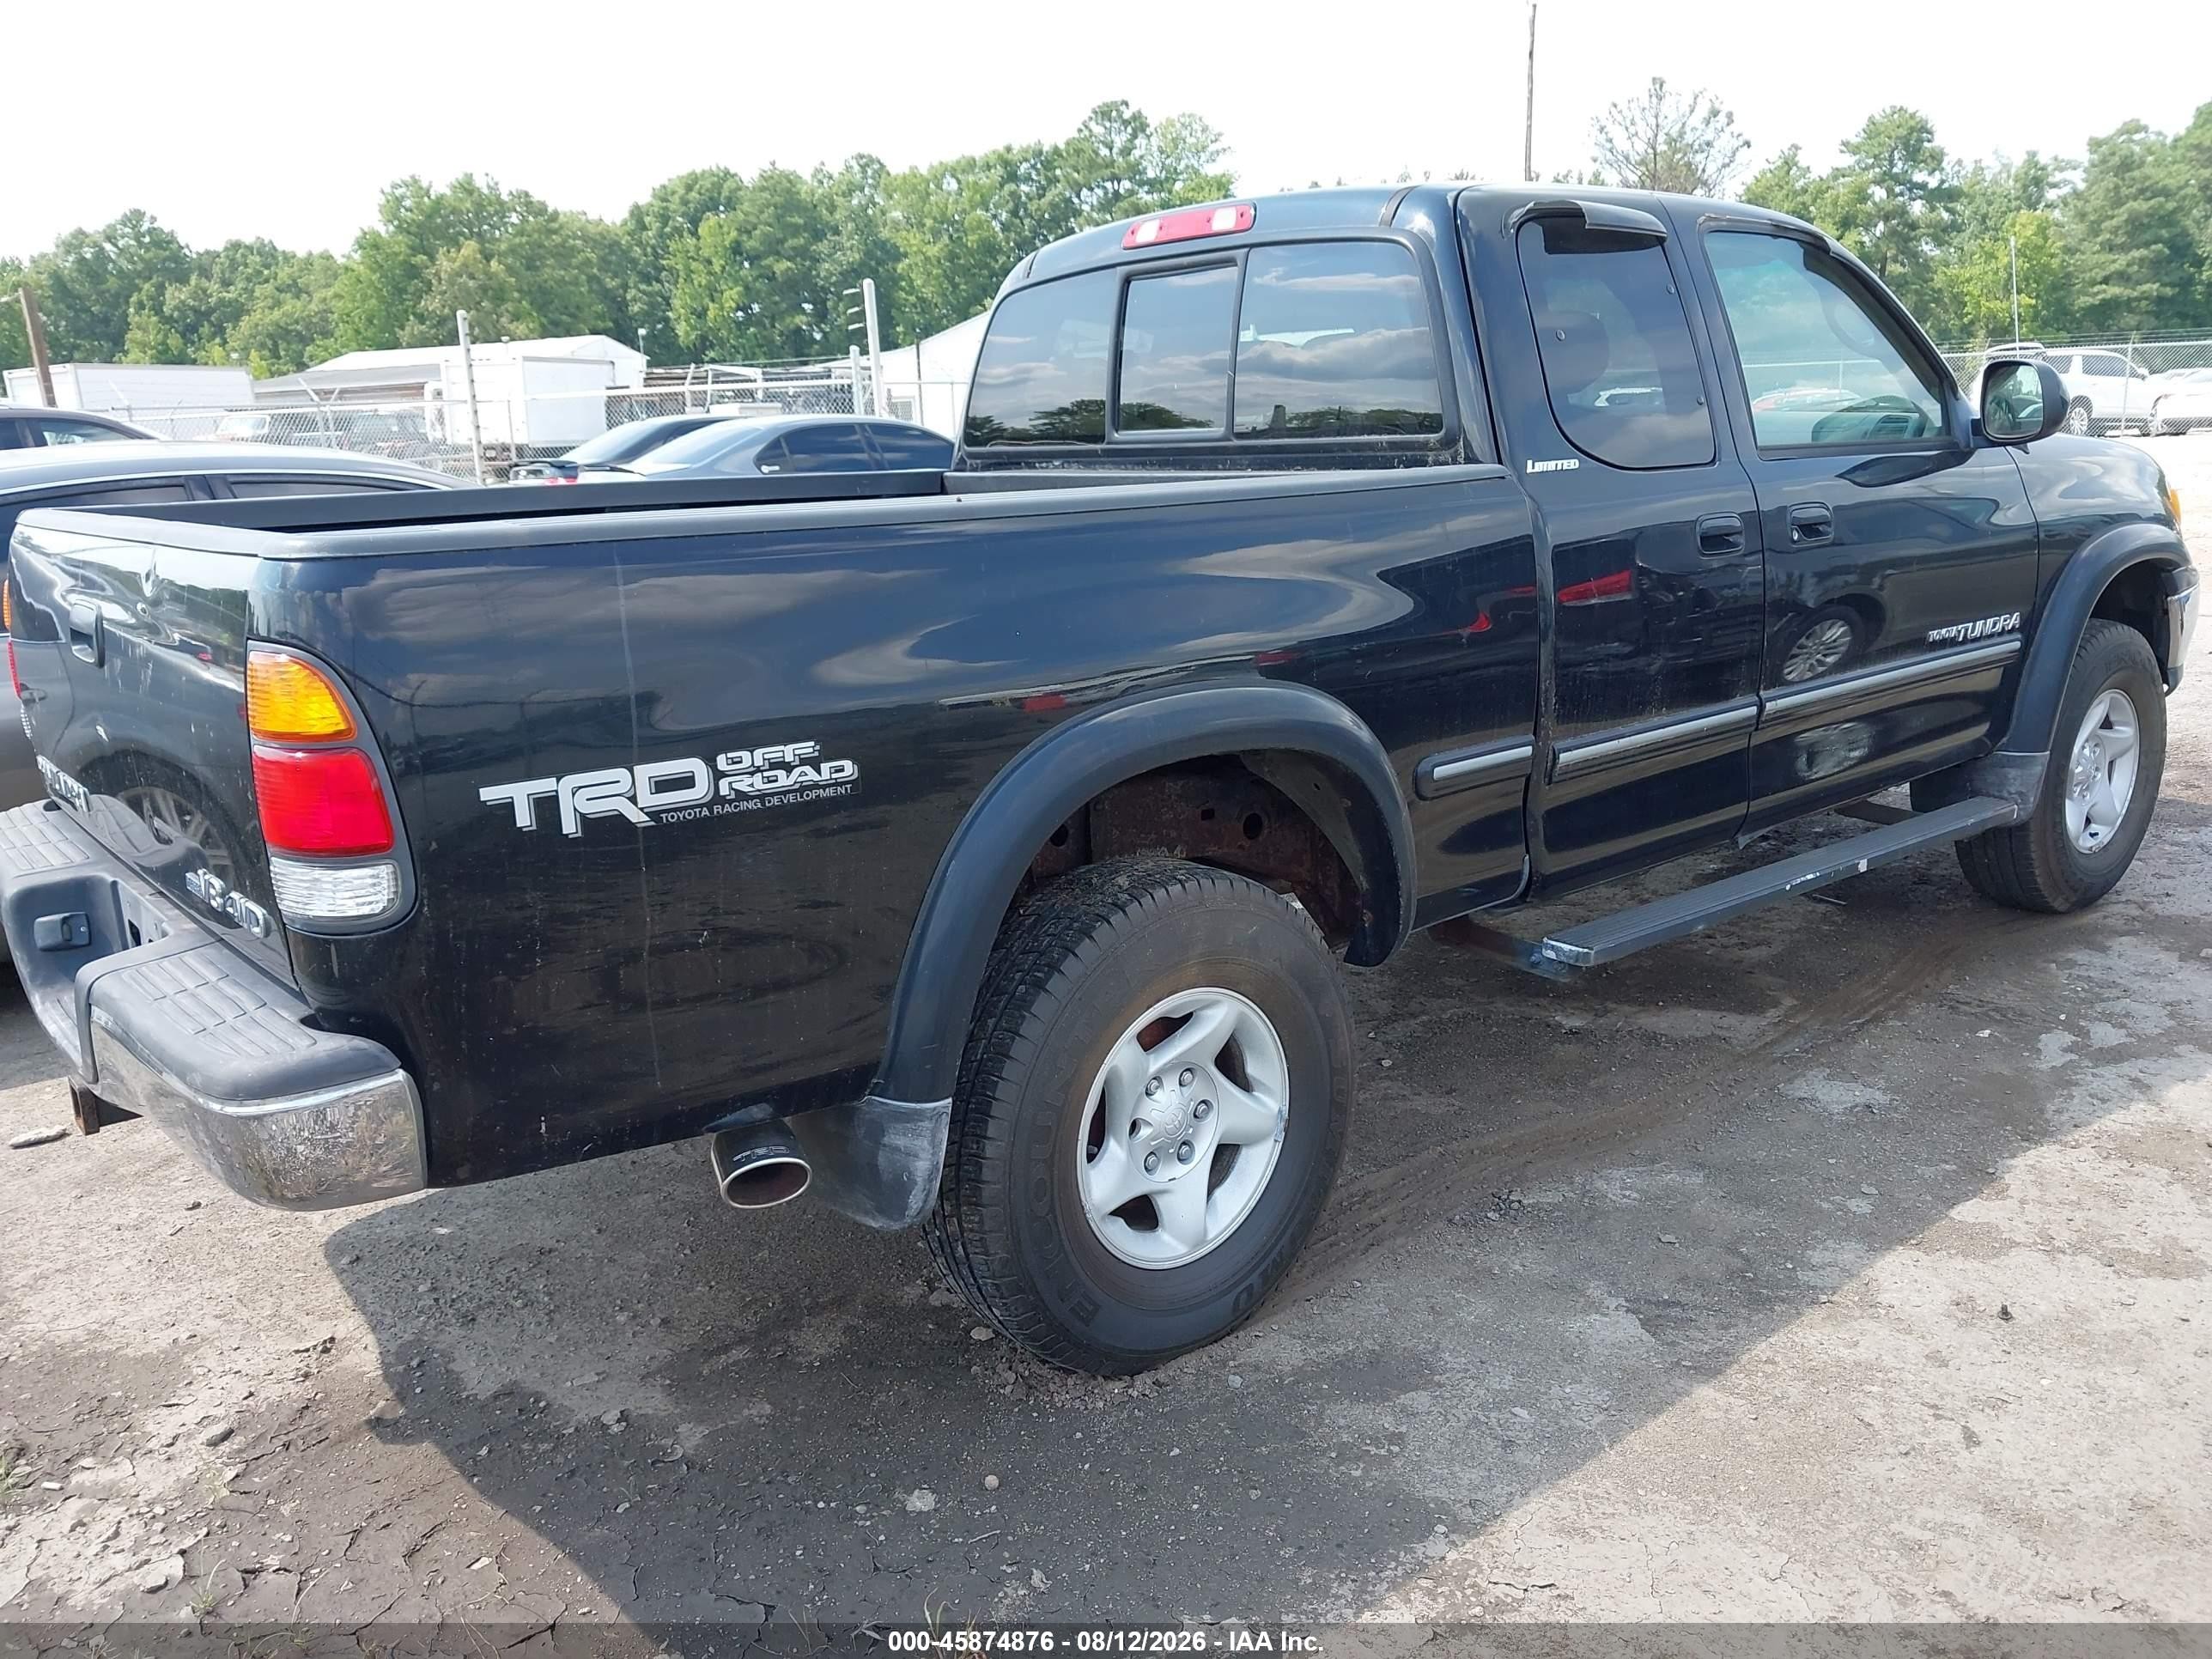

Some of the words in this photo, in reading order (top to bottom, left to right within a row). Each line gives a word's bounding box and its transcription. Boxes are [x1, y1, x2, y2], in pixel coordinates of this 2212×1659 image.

[1957, 611, 2021, 642] TUNDRA
[716, 741, 820, 775] OFF
[478, 757, 714, 838] TRD
[718, 759, 859, 799] ROAD
[659, 806, 711, 823] TOYOTA
[713, 799, 762, 815] RACING
[765, 783, 853, 806] DEVELOPMENT
[732, 1146, 790, 1162] TRD
